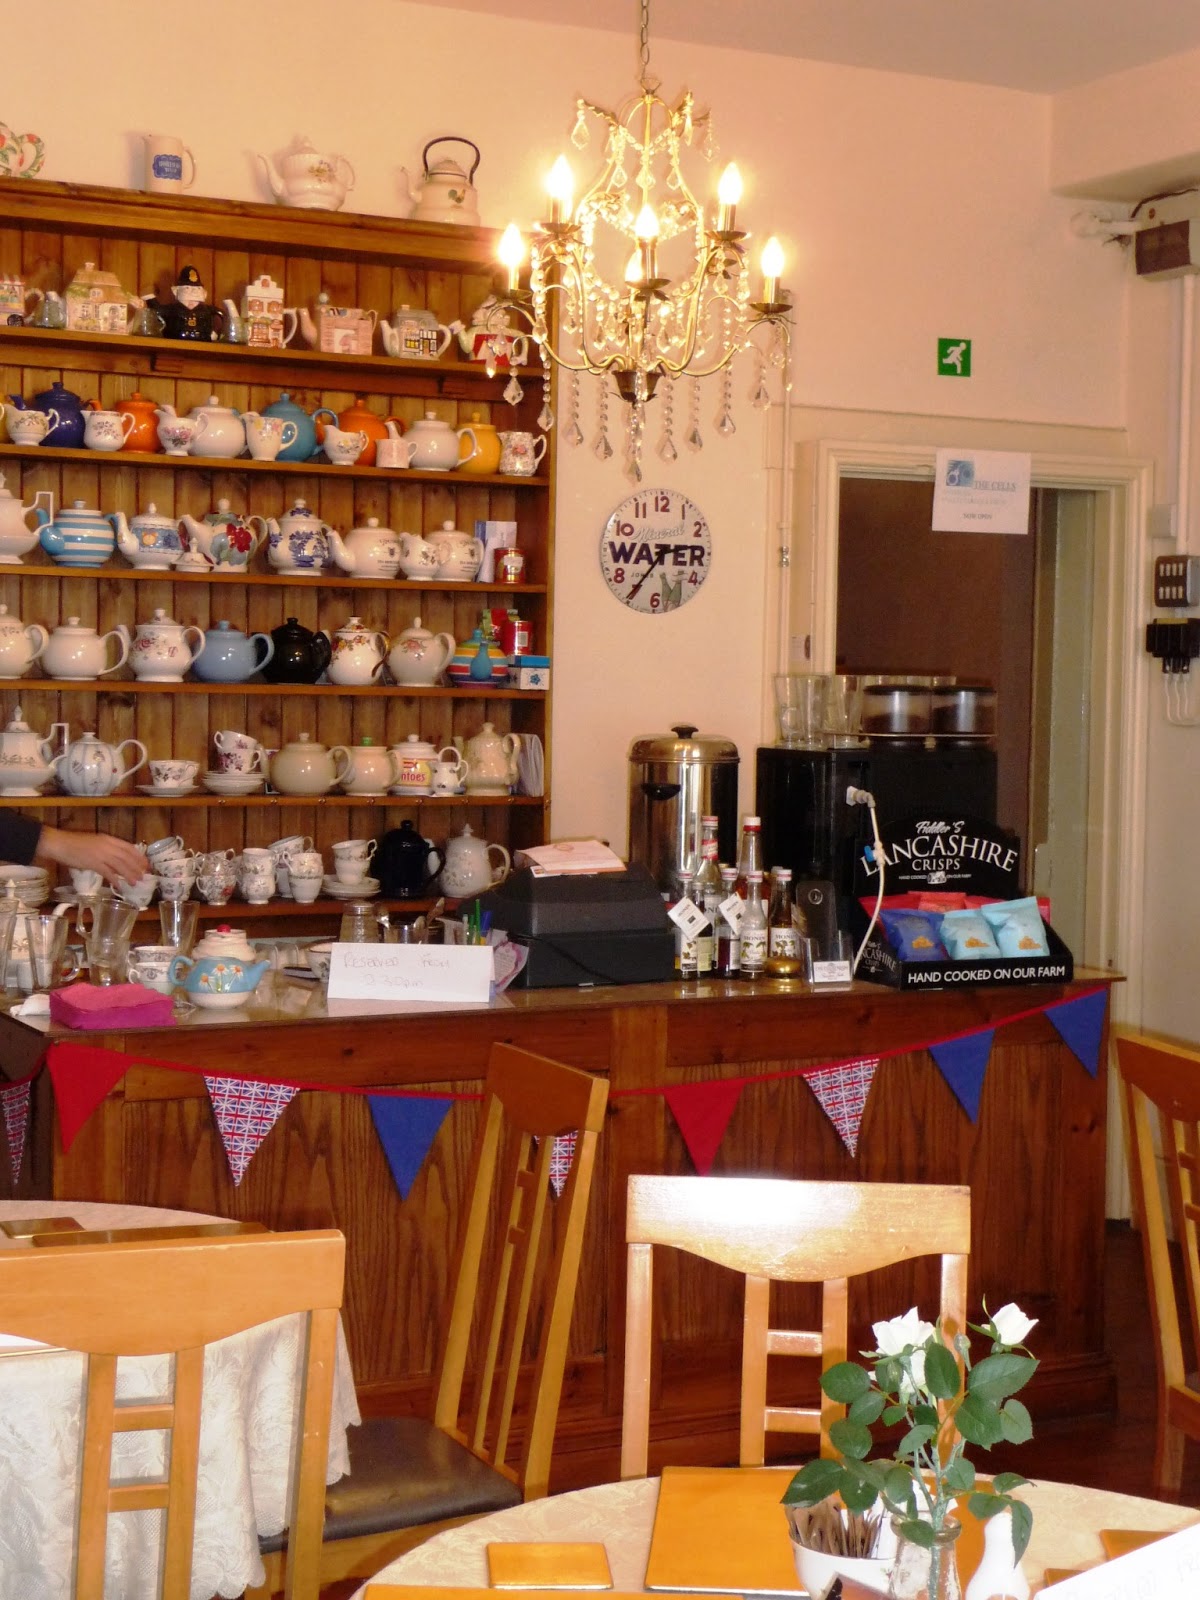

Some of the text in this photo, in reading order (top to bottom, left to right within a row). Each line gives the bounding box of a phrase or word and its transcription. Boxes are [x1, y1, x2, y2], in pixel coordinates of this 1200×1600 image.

[635, 501, 646, 518] 11
[654, 495, 670, 512] 12
[682, 503, 685, 520] 1
[616, 520, 634, 536] 10
[693, 521, 702, 537] 2
[608, 541, 705, 566] WATER
[613, 567, 625, 583] 8
[687, 571, 698, 585] 4
[650, 592, 660, 608] 6
[911, 858, 960, 871] CRISPS
[908, 965, 1065, 983] HAND COOKED ON OUR FARM
